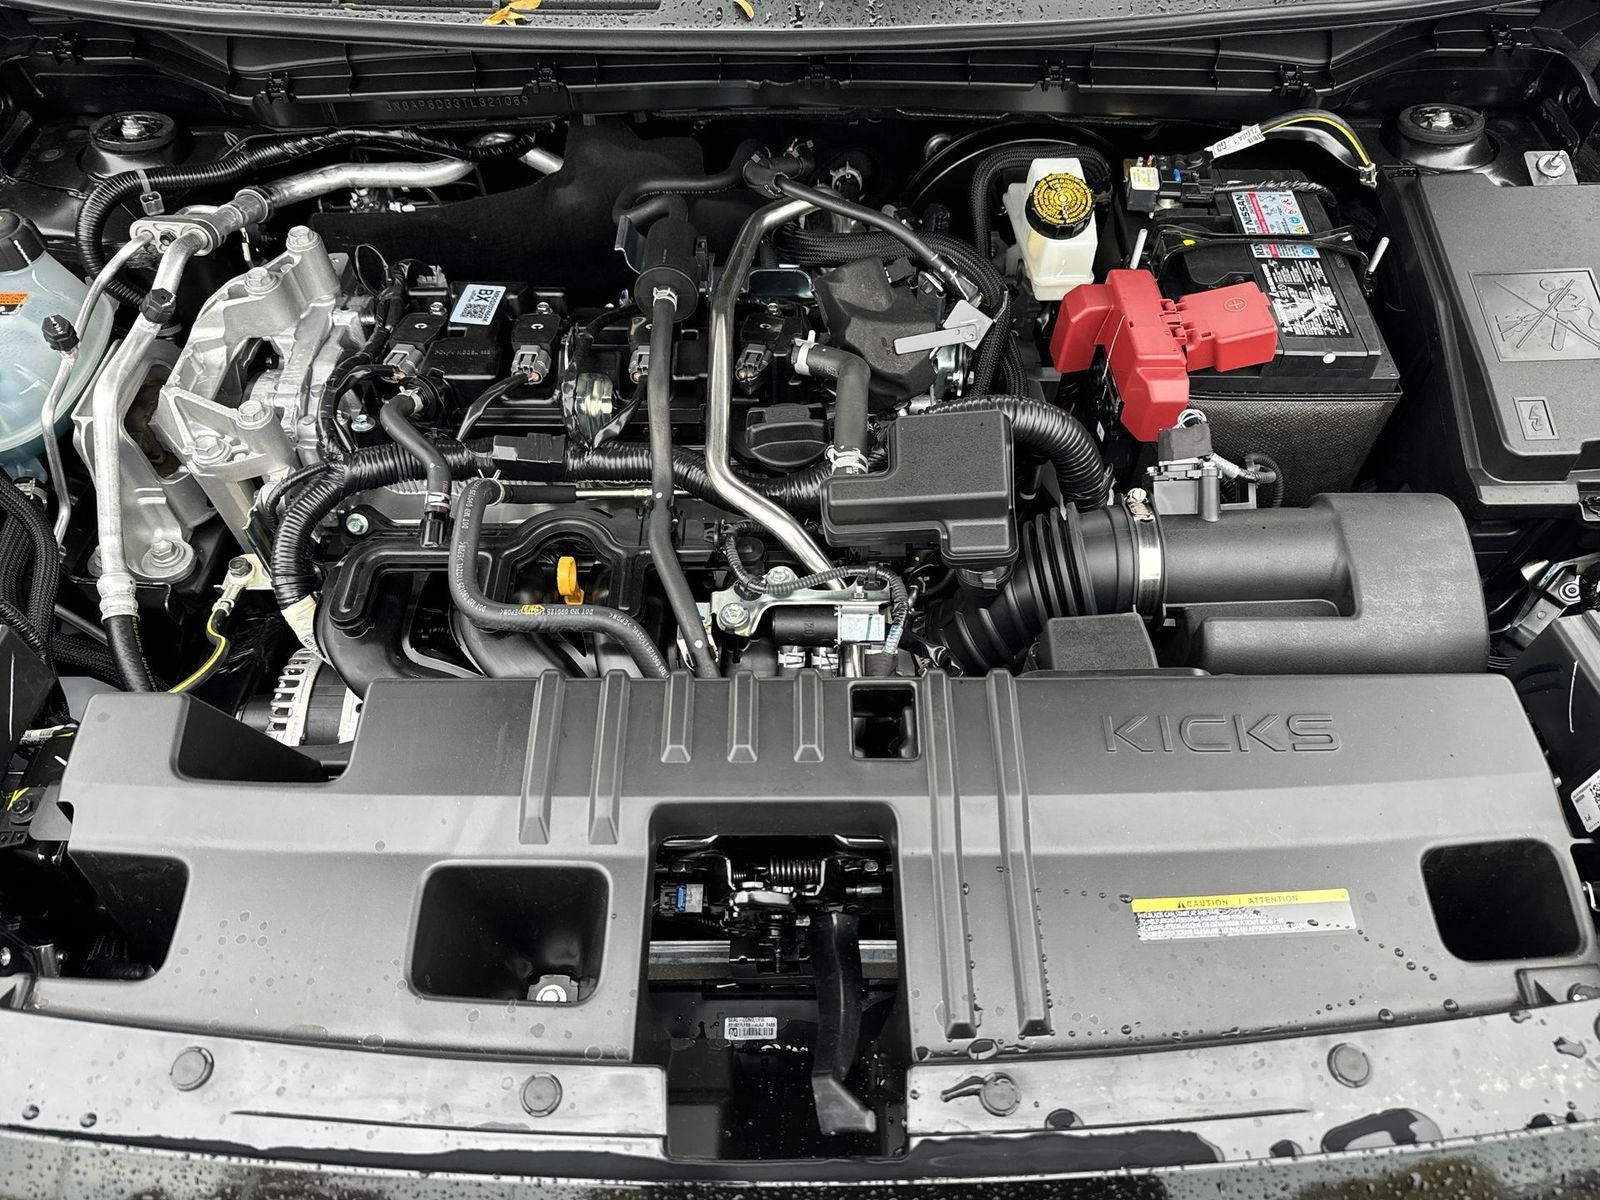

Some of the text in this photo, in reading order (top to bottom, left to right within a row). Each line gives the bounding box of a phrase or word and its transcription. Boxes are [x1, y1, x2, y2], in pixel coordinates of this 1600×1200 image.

[474, 288, 494, 303] BX
[1102, 713, 1340, 752] KICKS
[1186, 899, 1229, 908] CAUTION
[1248, 895, 1299, 905] ATTENTION
